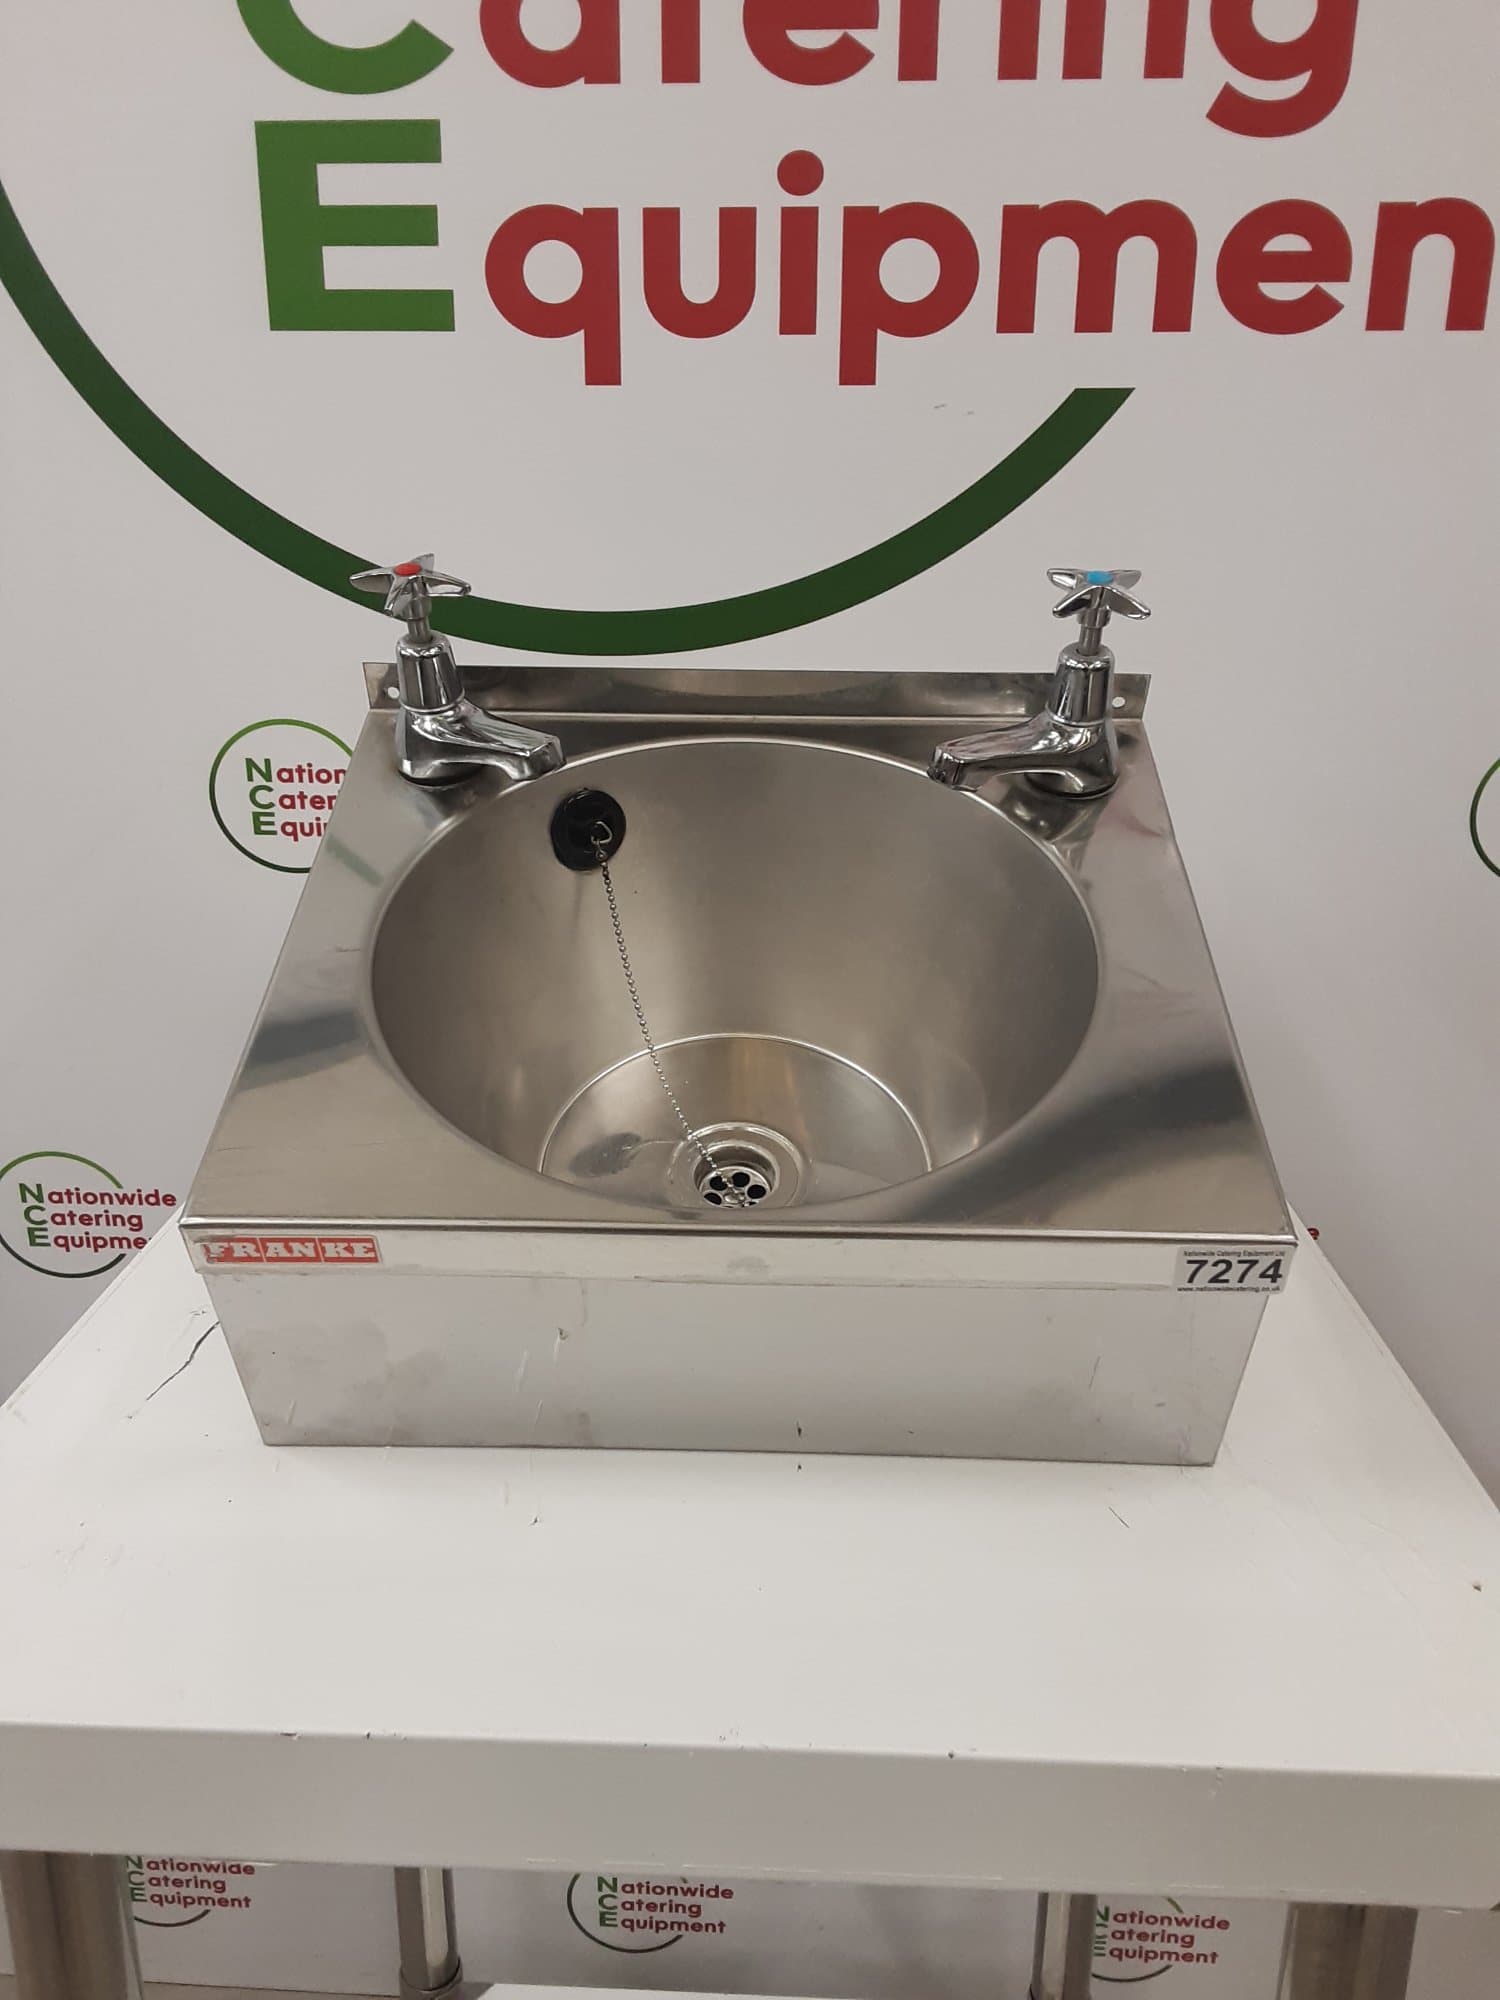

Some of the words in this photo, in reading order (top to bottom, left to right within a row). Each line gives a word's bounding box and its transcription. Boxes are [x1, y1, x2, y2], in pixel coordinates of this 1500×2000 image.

[251, 811, 329, 842] Equi
[19, 1183, 177, 1207] Nationwide
[23, 1205, 144, 1232] Catering
[26, 1227, 151, 1252] Equipme
[206, 1241, 376, 1258] FRANKE
[1186, 1259, 1283, 1284] 7274
[125, 1855, 255, 1875] Nationwide
[127, 1870, 226, 1893] Catering
[597, 1876, 735, 1900] Nationwide
[130, 1887, 252, 1909] Equipment
[598, 1893, 702, 1918] Catering
[599, 1911, 727, 1934] Equipment
